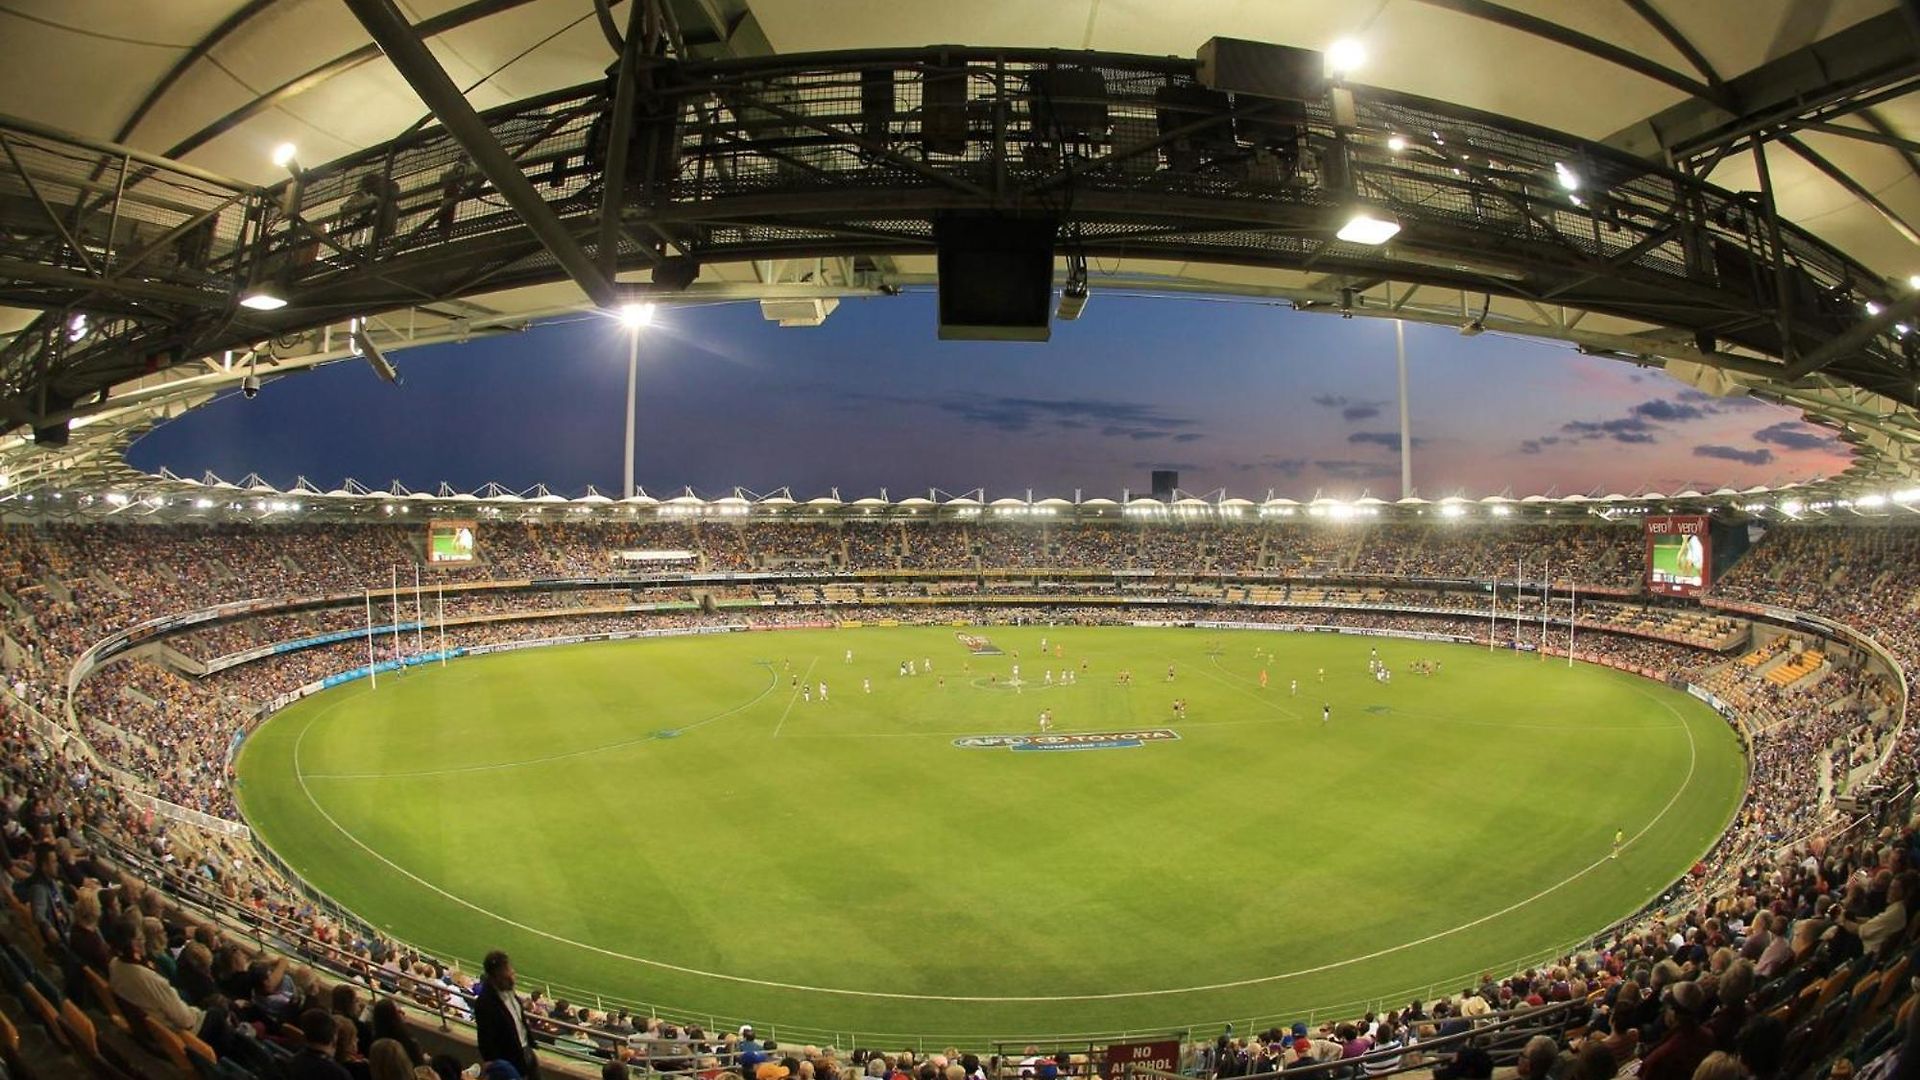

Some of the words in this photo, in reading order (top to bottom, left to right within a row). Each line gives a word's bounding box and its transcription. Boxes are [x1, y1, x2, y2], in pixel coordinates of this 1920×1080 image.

[1648, 522, 1668, 533] vero
[1678, 522, 1698, 533] vero
[1070, 732, 1169, 742] TOYOTA
[1133, 1046, 1152, 1058] NO
[1111, 1059, 1172, 1073] ALOHOL
